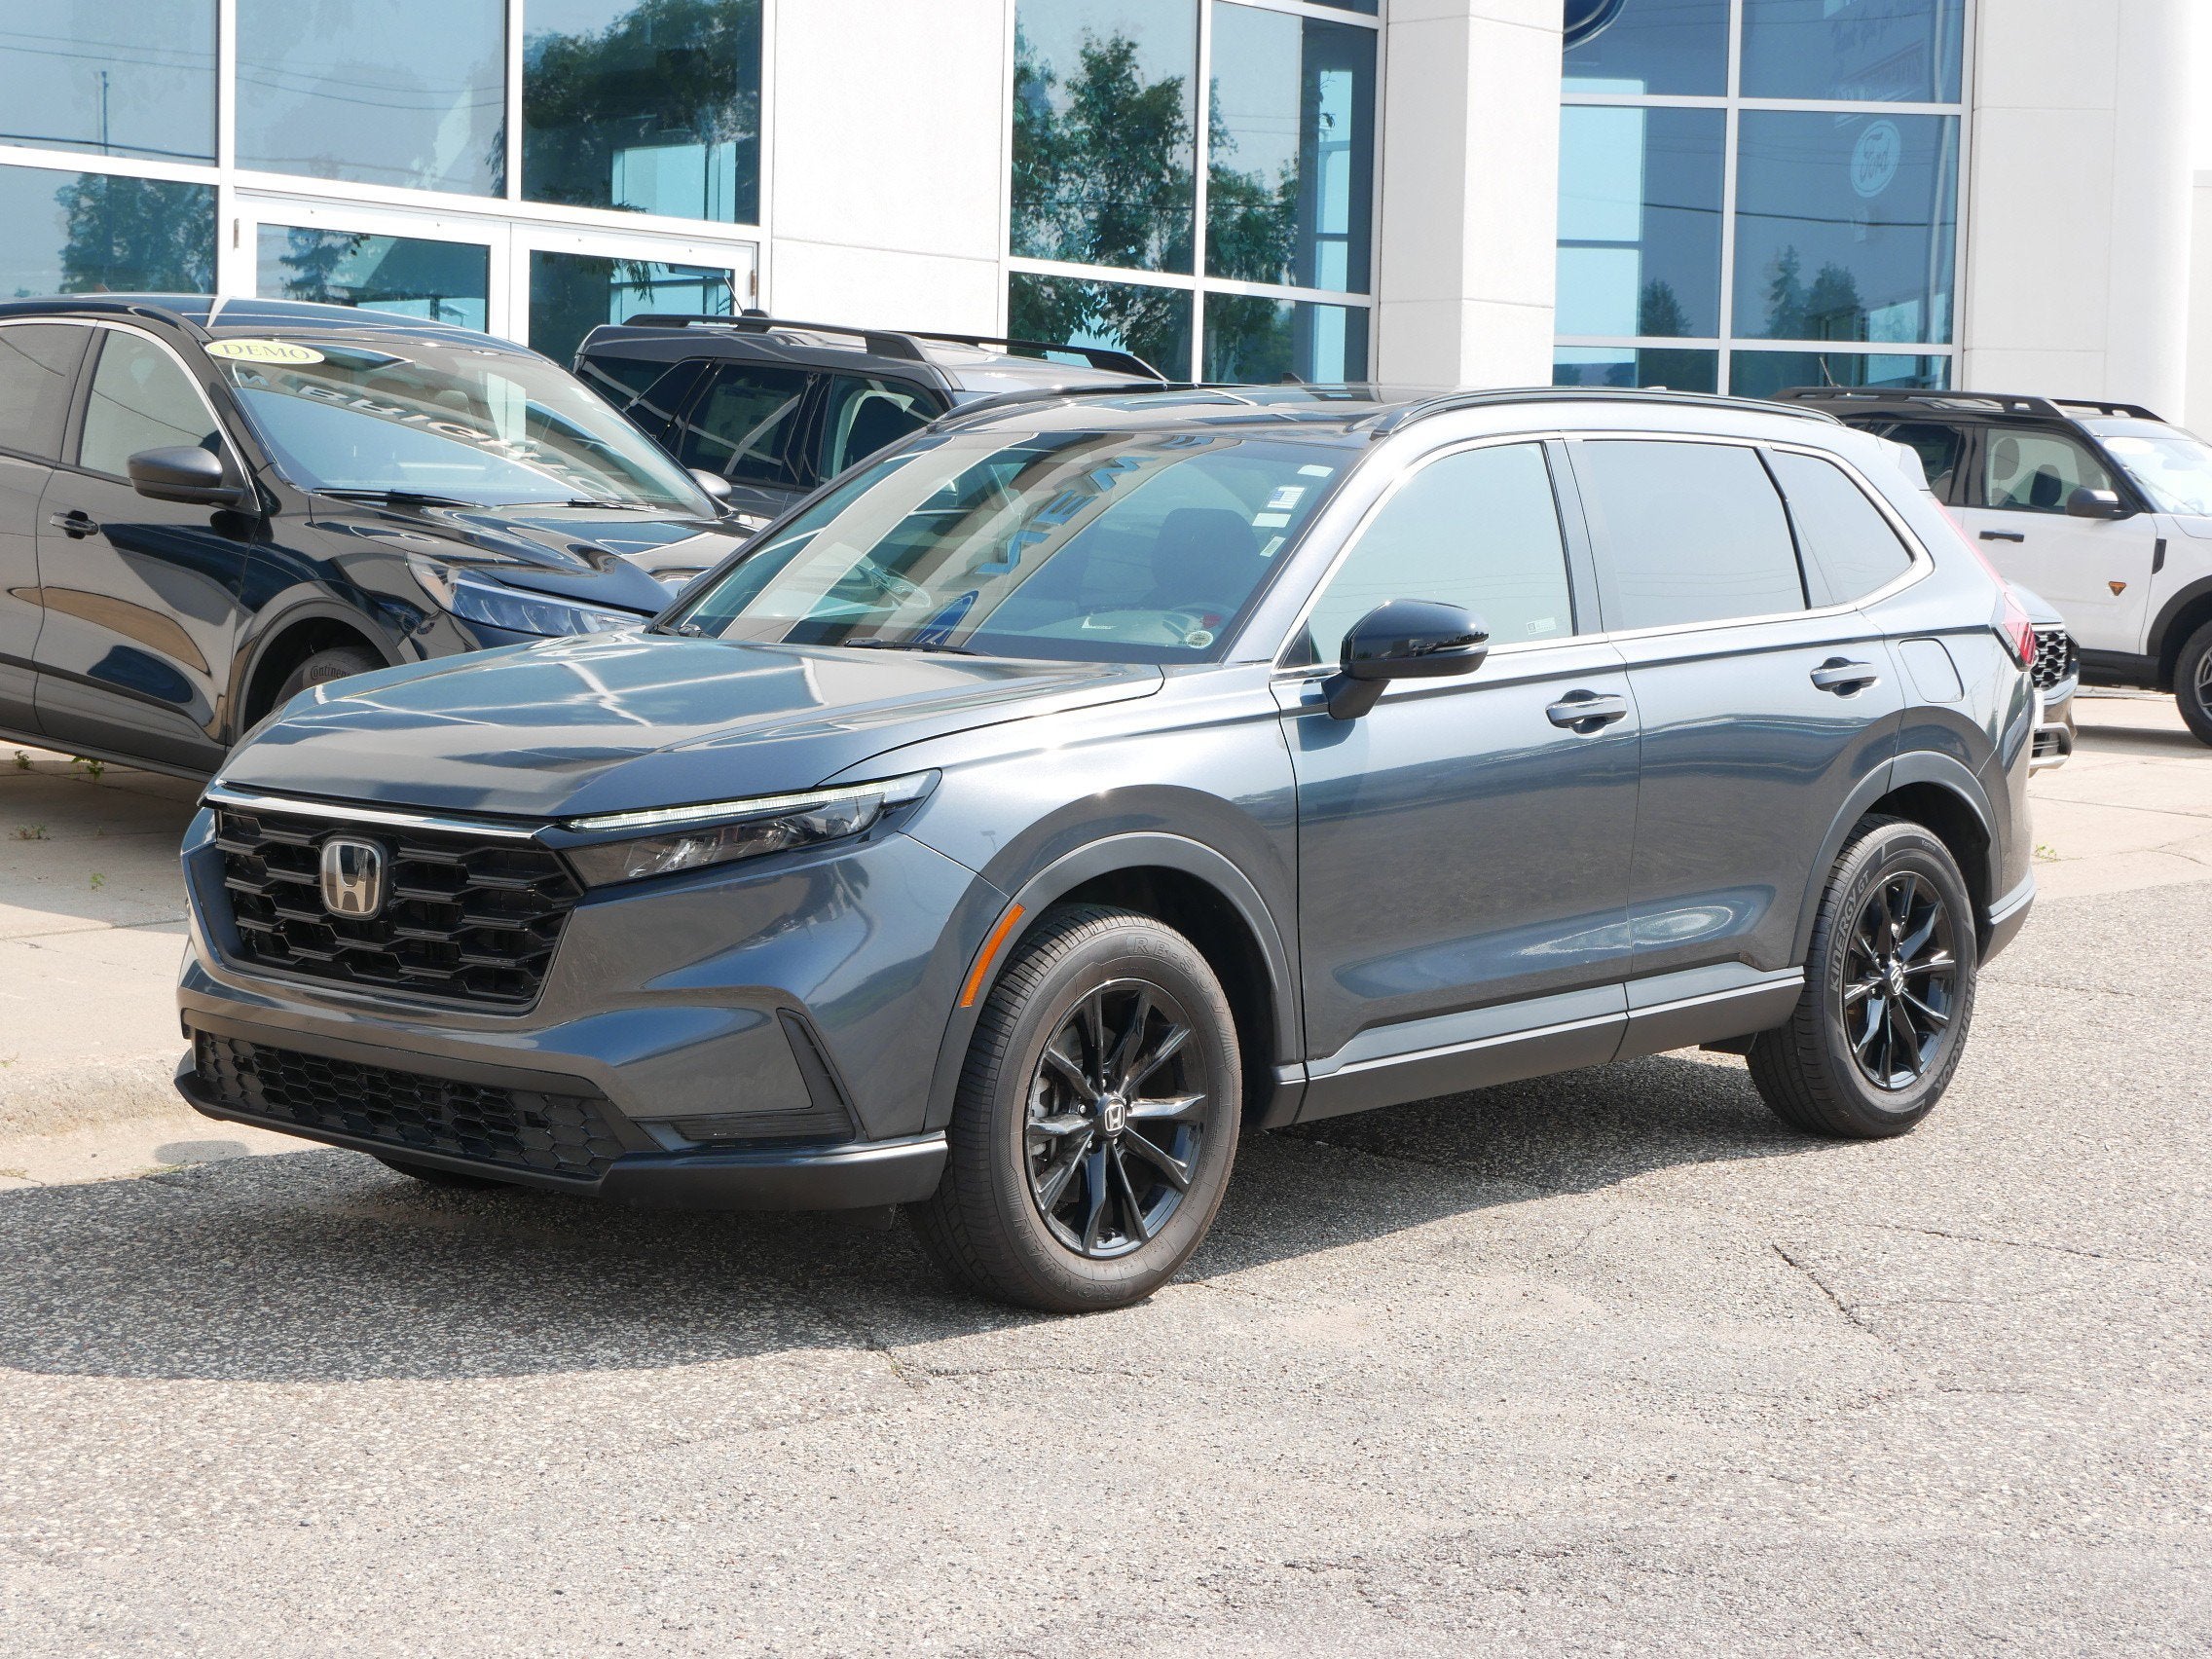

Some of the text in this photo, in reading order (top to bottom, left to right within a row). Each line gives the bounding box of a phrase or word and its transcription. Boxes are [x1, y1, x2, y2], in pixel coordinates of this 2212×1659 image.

[221, 344, 311, 360] DEMO
[1829, 869, 1869, 993] KINERGY GT
